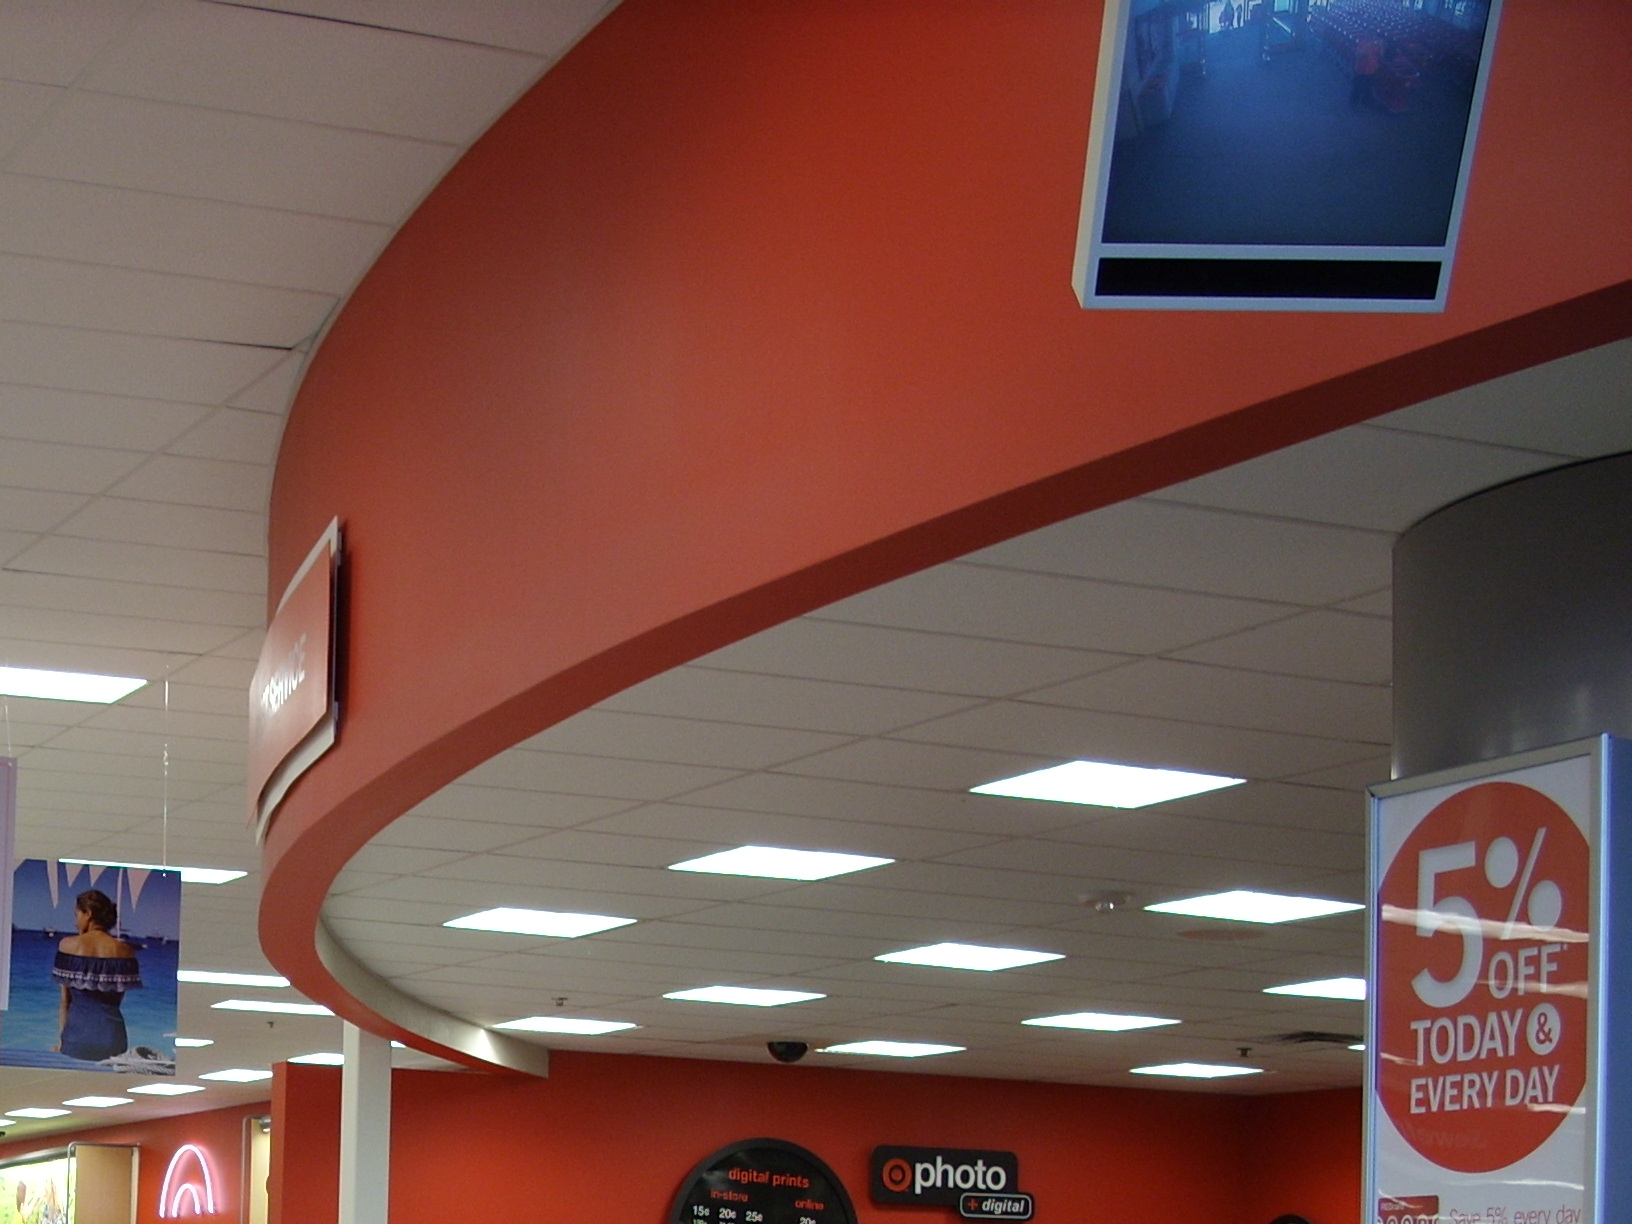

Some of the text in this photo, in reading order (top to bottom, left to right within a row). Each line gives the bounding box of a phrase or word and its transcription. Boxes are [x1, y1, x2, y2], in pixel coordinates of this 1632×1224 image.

[1411, 826, 1563, 1009] 5%
[1410, 1008, 1523, 1066] TODAY
[1409, 1064, 1561, 1115] EVERY DAY
[728, 1168, 810, 1188] digital prints
[914, 1155, 1007, 1195] photo
[982, 1198, 1025, 1215] digital
